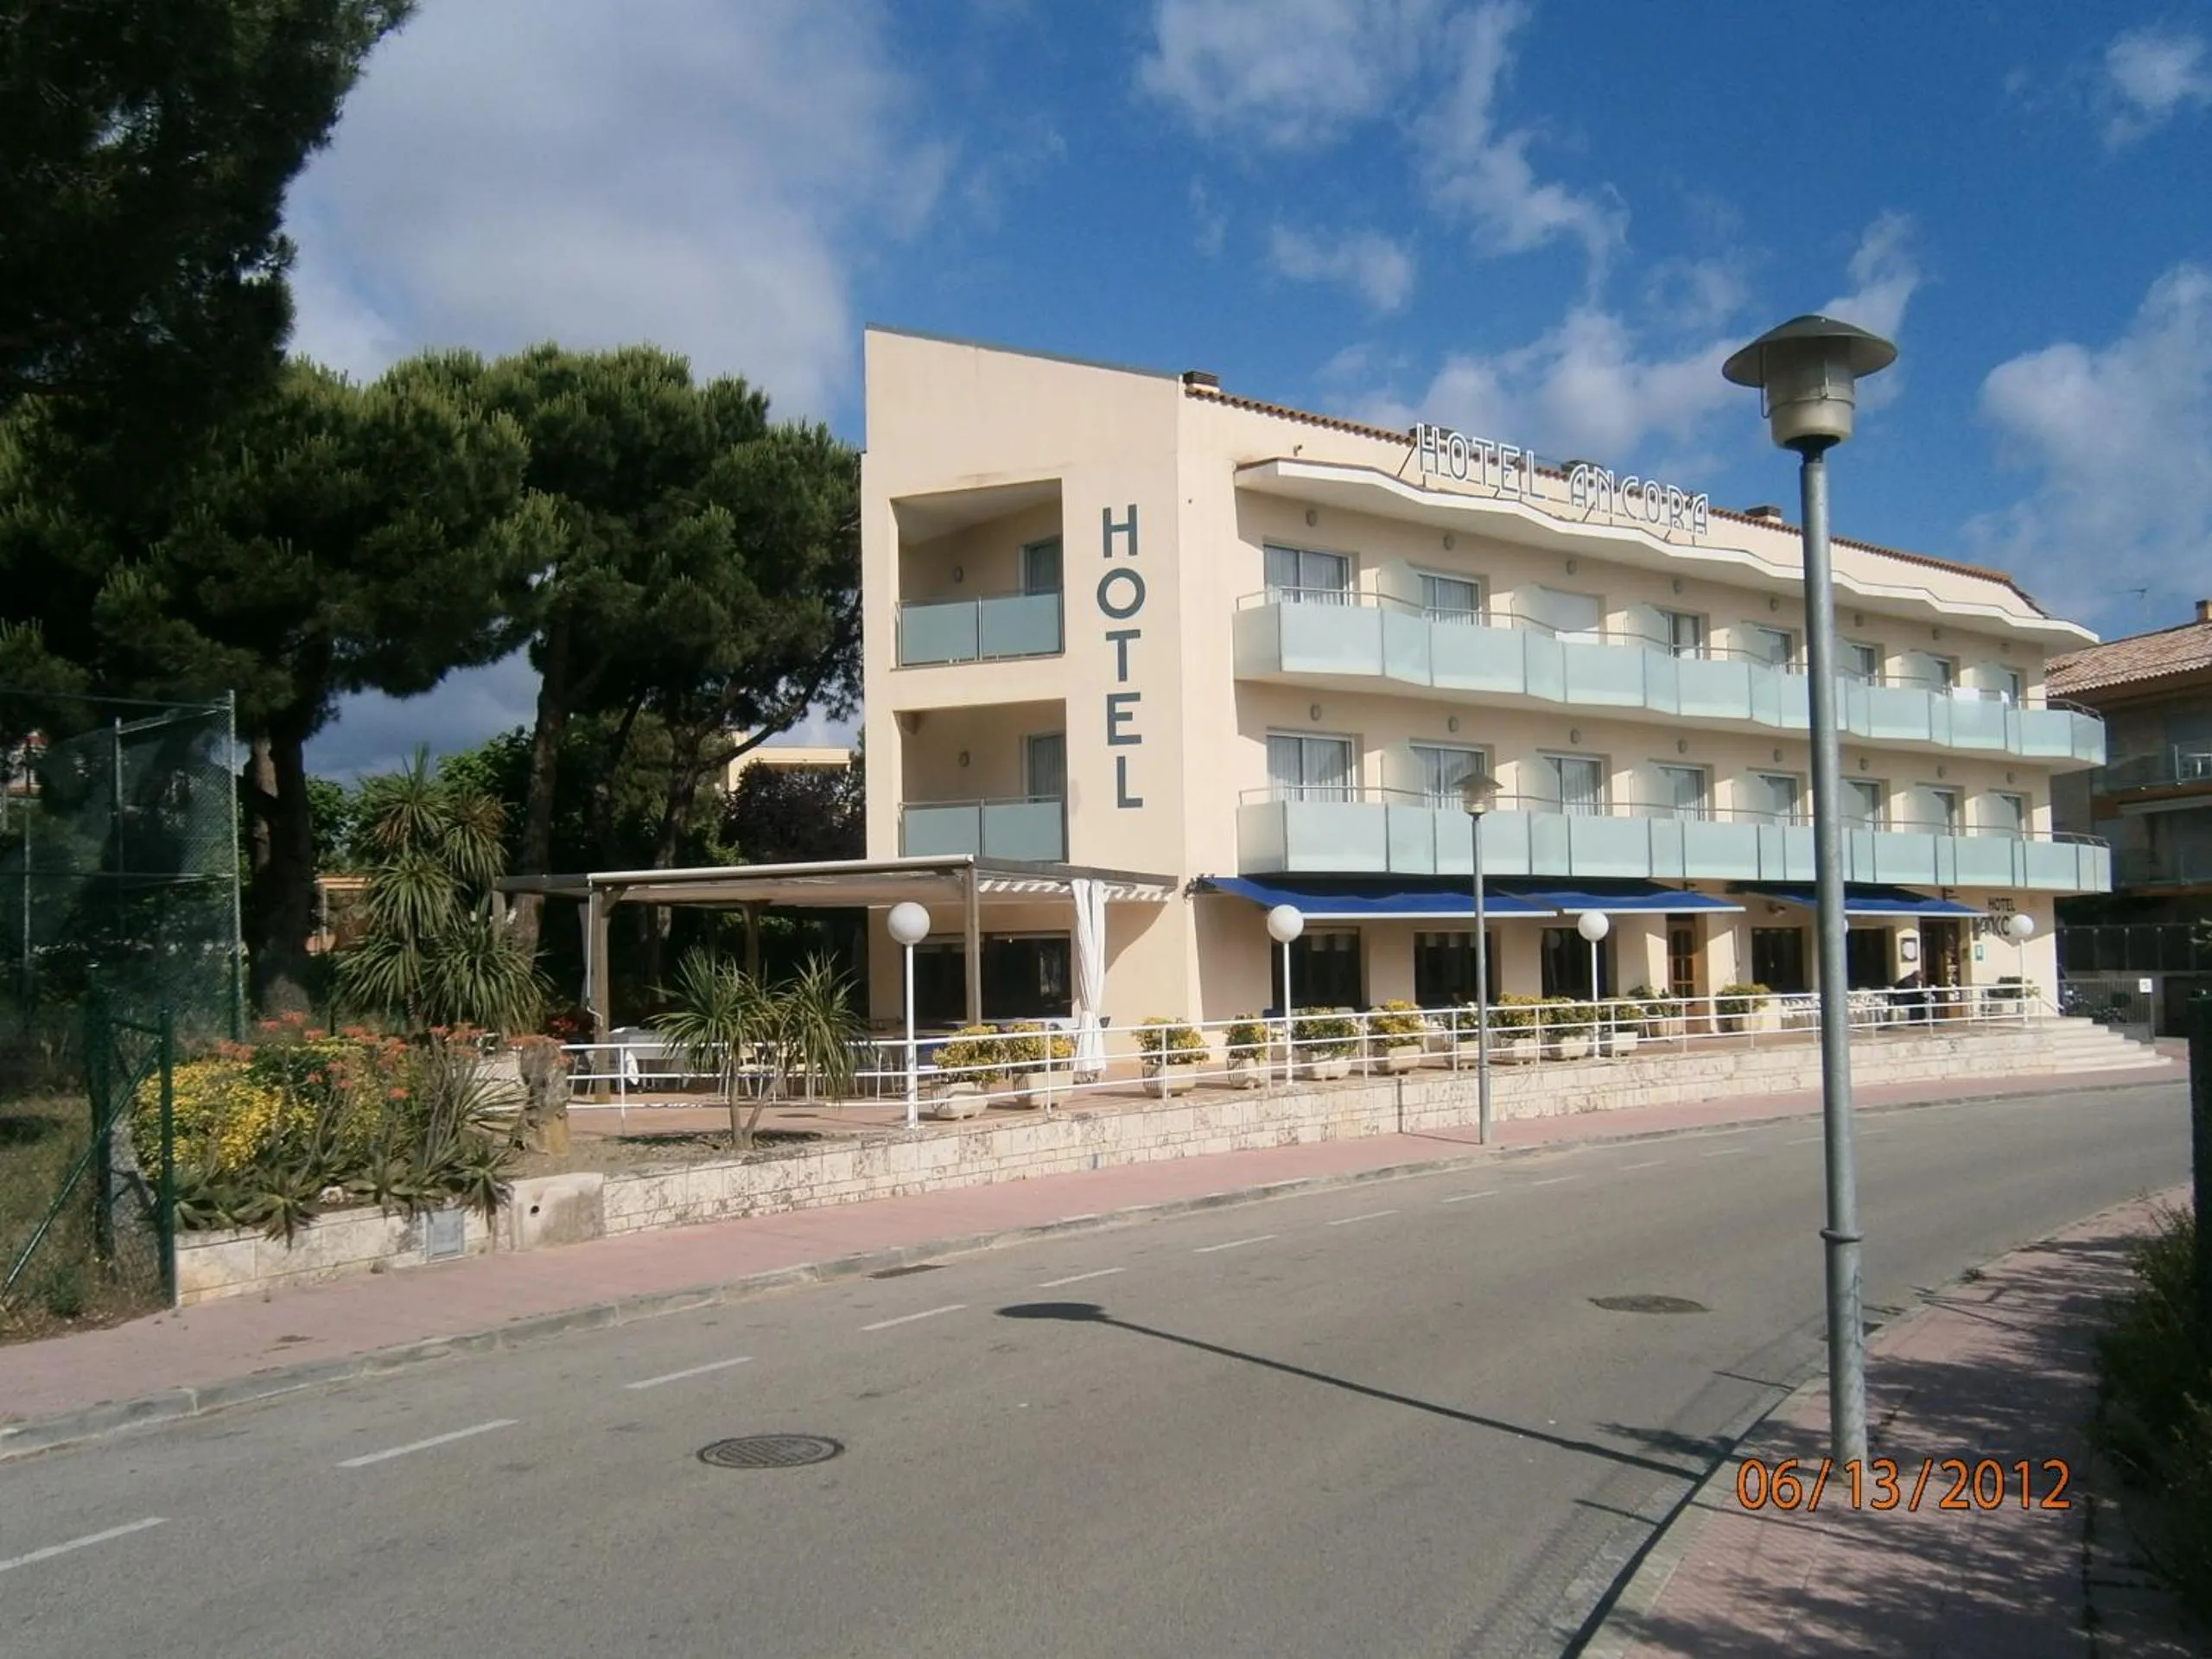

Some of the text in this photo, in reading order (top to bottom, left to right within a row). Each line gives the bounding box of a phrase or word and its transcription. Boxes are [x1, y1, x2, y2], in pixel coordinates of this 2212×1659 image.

[1416, 423, 1708, 535] HOTEL ANCORA
[1096, 504, 1146, 809] HOTEL
[1988, 897, 2016, 912] HOTEL
